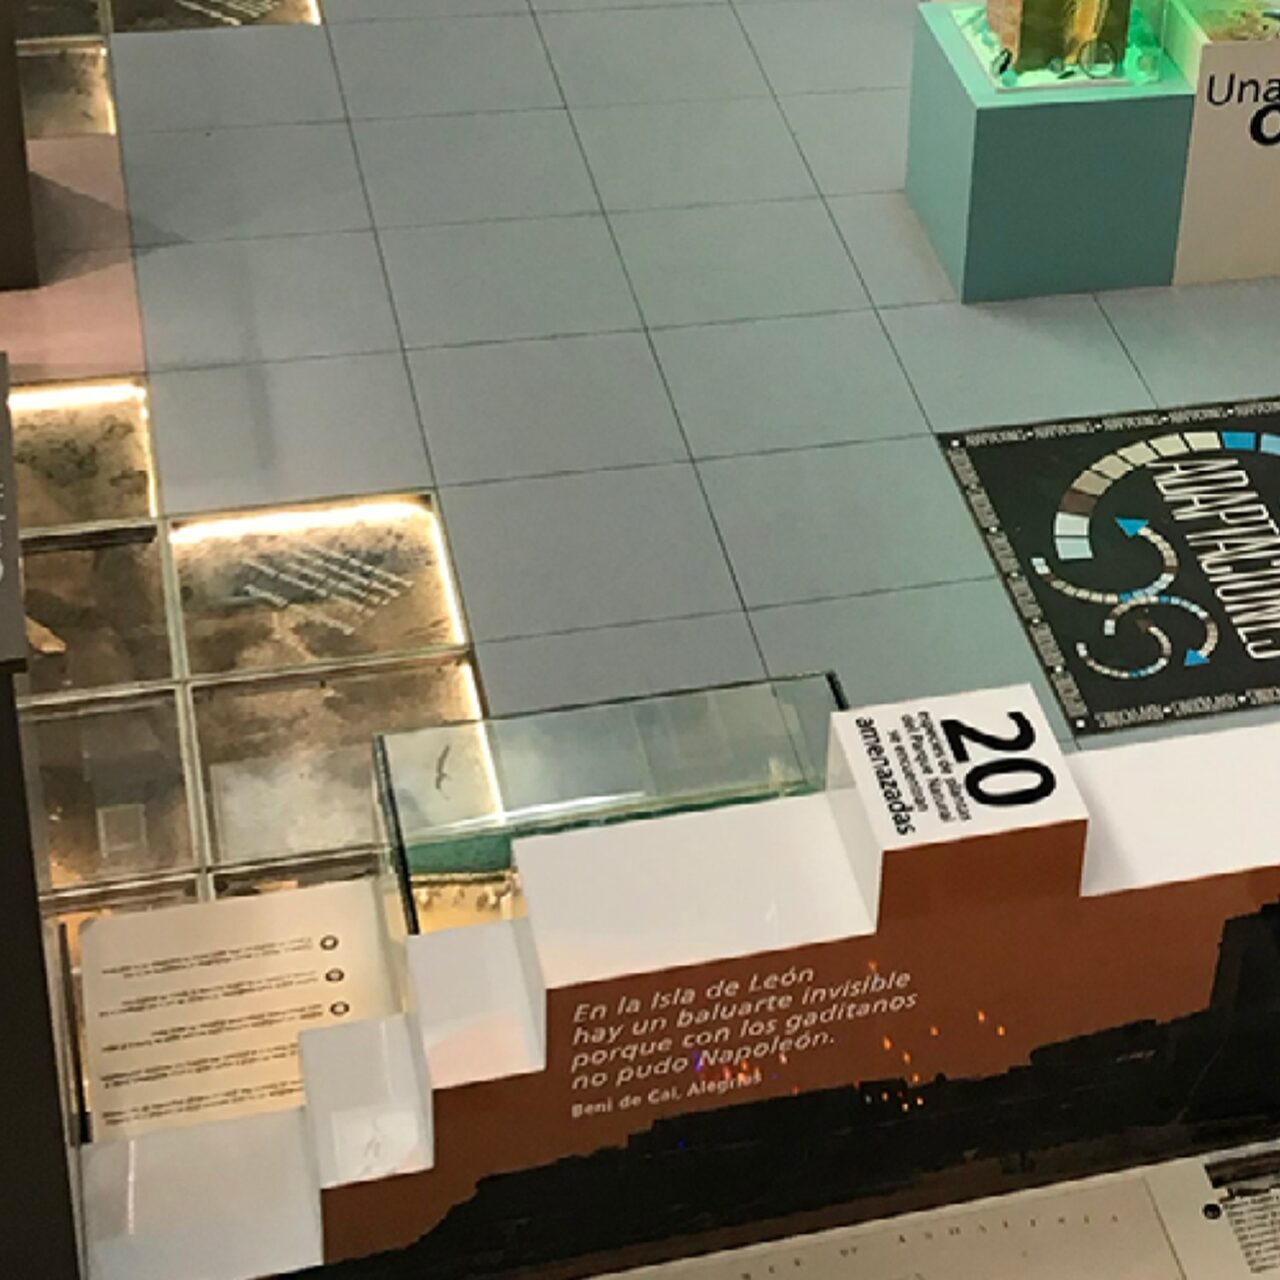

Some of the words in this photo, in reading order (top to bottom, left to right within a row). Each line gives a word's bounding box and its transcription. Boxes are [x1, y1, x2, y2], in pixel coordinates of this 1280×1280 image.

[855, 716, 916, 836] amenazadas
[940, 711, 1056, 807] 20
[572, 1023, 624, 1046] hay
[632, 1016, 668, 1037] un
[676, 993, 793, 1029] baluarte
[801, 970, 912, 1006] invisible
[573, 1003, 607, 1023] En
[617, 995, 642, 1015] la
[650, 987, 696, 1011] Isla
[706, 978, 740, 1000] de
[748, 965, 815, 993] León
[571, 1036, 673, 1074] porque
[681, 1025, 731, 1049] con
[740, 1018, 777, 1038] los
[785, 991, 919, 1036] gaditanos
[571, 1071, 609, 1090] no
[615, 1054, 689, 1089] pudo
[699, 1030, 836, 1068] Napoleón.
[571, 1096, 614, 1119] Beni
[618, 1093, 643, 1111] de
